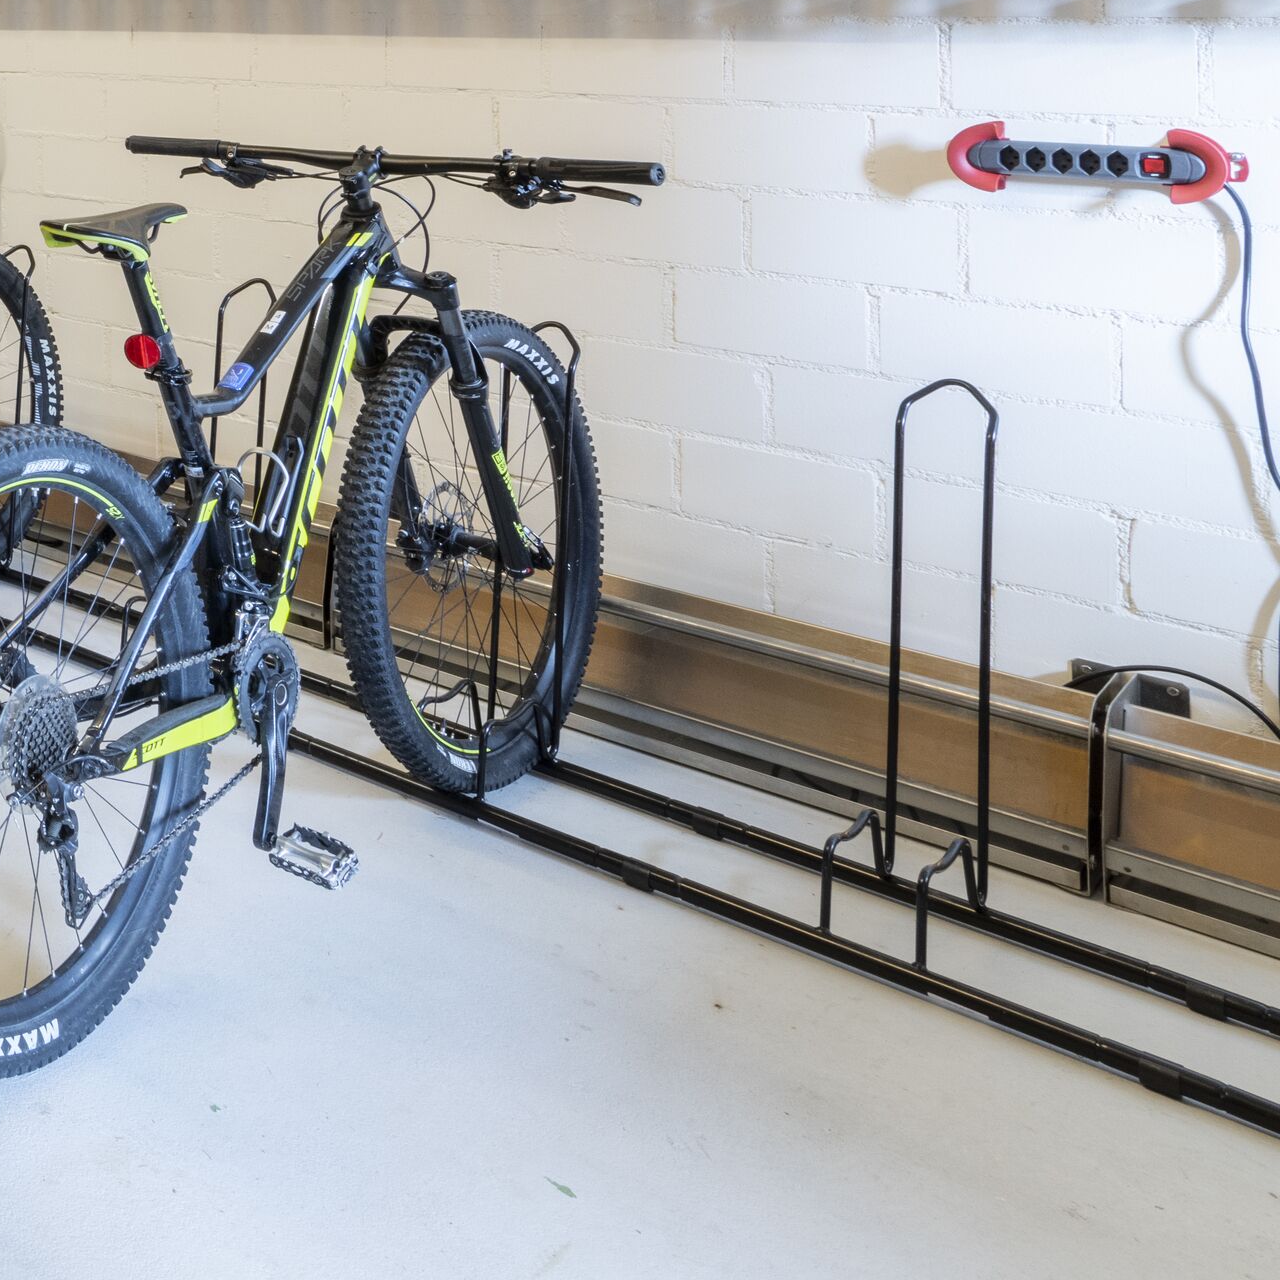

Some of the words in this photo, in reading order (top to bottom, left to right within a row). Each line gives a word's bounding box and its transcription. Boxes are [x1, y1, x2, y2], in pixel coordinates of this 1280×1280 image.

[286, 239, 342, 302] SPARK
[39, 338, 58, 417] MAXXIS
[503, 338, 560, 385] MAXXIS
